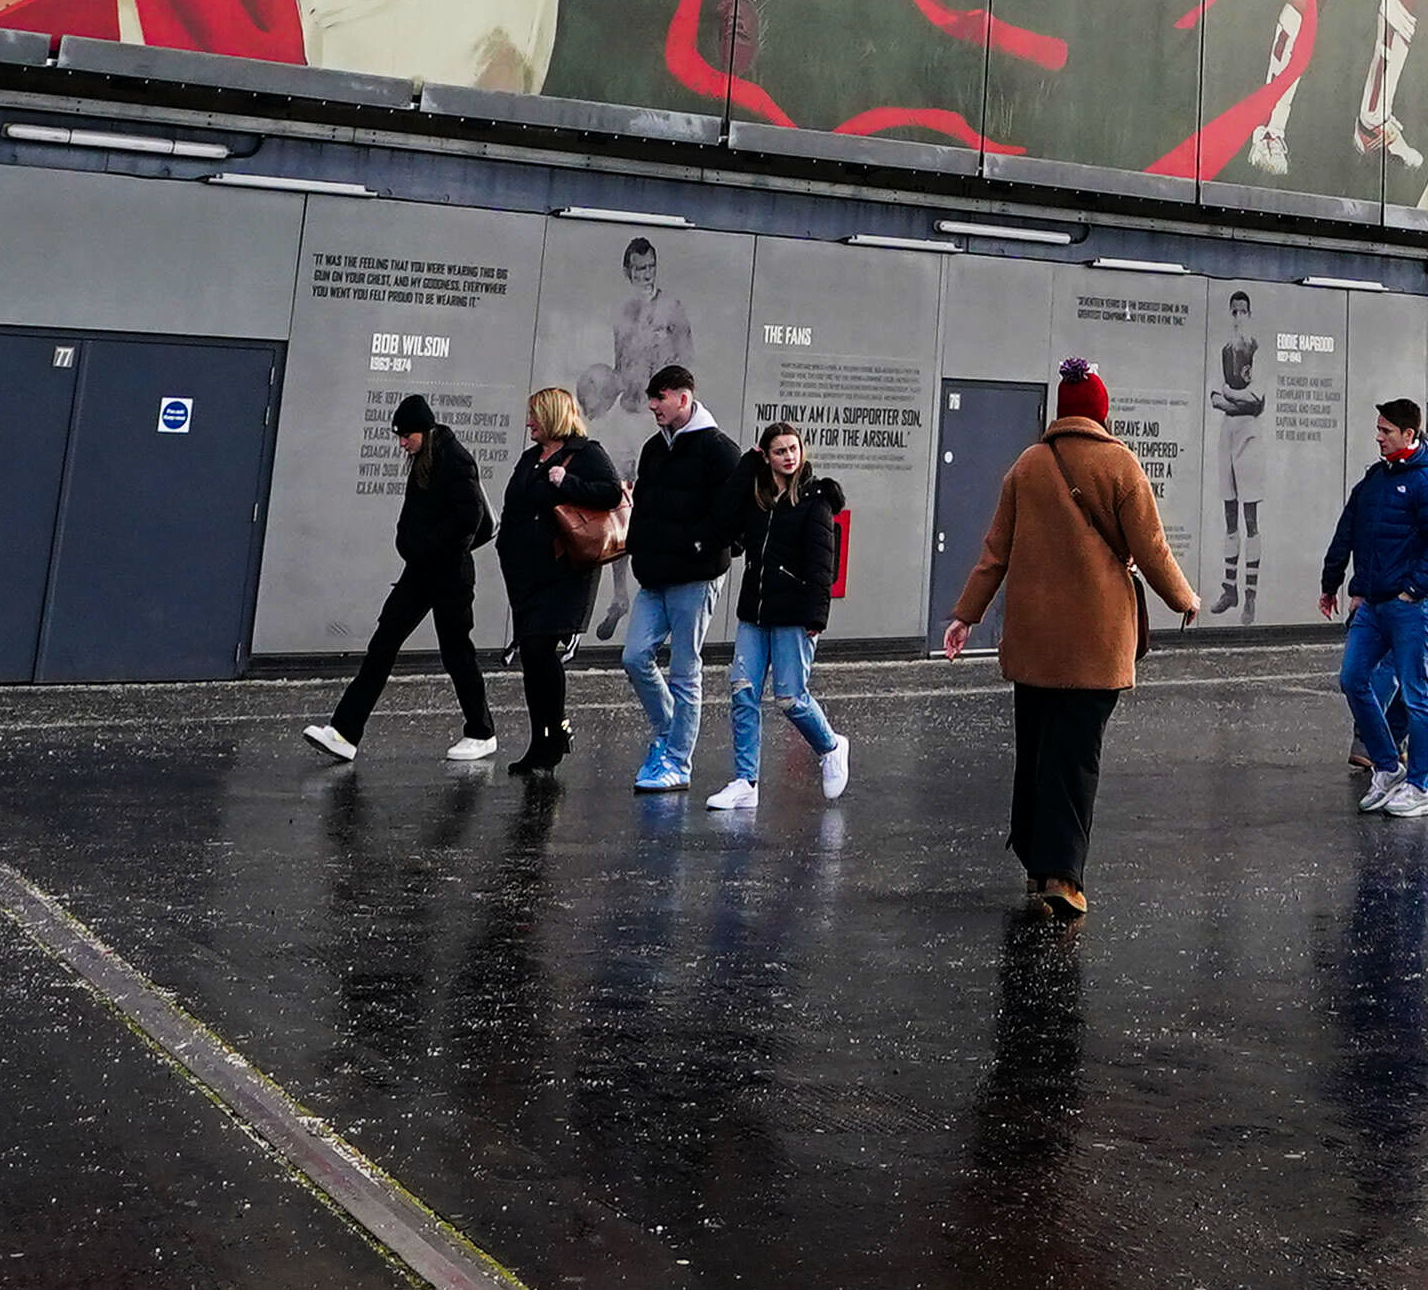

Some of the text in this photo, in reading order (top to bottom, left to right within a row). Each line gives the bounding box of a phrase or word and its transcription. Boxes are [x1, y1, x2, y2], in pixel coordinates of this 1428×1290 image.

[325, 255, 342, 268] WAS
[344, 256, 358, 269] THE
[359, 257, 389, 270] FEELING
[390, 259, 409, 272] THAT
[410, 260, 425, 273] YOU
[427, 262, 446, 275] WERE
[447, 264, 478, 278] WEARING
[479, 266, 495, 279] THIS
[344, 272, 366, 285] YOUR
[394, 275, 409, 288] AND
[411, 276, 422, 289] MY
[462, 280, 507, 295] EVERYWHERE
[312, 286, 328, 298] YOU
[330, 287, 351, 300] WENT
[353, 288, 369, 301] YOU
[370, 289, 387, 302] FELT
[387, 290, 413, 304] PROUD
[413, 292, 424, 304] TO
[425, 293, 435, 305] BE
[436, 294, 468, 308] WEARING
[764, 325, 812, 346] THE FANS
[372, 332, 451, 358] BOB WILSON
[367, 390, 383, 405] THE
[472, 413, 498, 426] SPENT
[780, 404, 807, 422] ONLY
[808, 406, 825, 423] AM
[833, 407, 840, 425] A
[842, 407, 900, 426] SUPPORTER
[901, 409, 922, 428] SON,
[363, 427, 391, 441] YEARS
[819, 428, 839, 446] FOR
[842, 429, 860, 447] THE
[1113, 420, 1159, 437] BRAVE AND
[360, 444, 509, 462] COACH PLAYER
[358, 463, 380, 477] WITH
[1166, 462, 1173, 479] A
[356, 482, 385, 495] CLEAN
